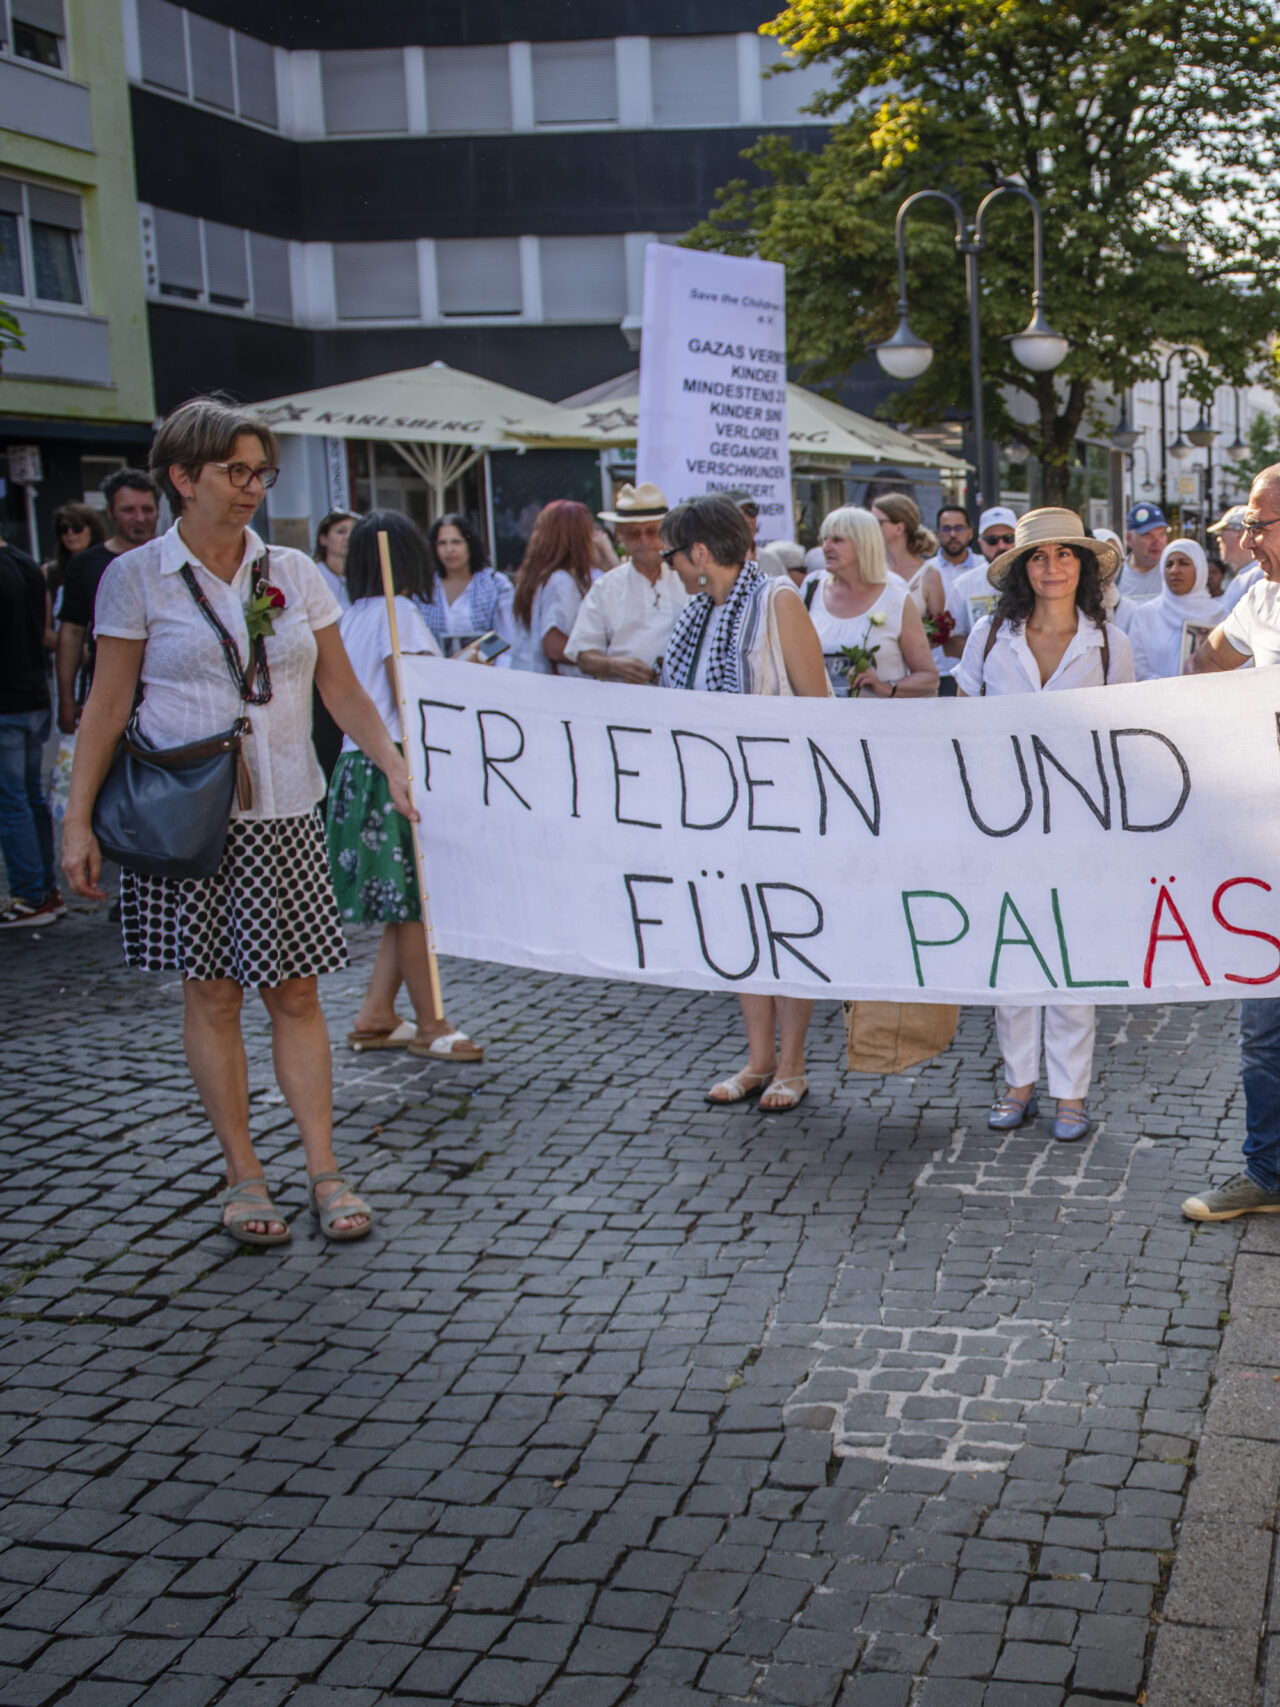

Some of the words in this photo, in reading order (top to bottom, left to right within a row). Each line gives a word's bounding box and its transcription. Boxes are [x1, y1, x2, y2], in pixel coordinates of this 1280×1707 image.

[691, 288, 718, 301] Save
[721, 294, 739, 304] the
[688, 338, 745, 359] GAZAS
[710, 396, 763, 420] KINDER
[315, 410, 484, 434] KARLSBERG
[418, 698, 882, 838] FRIEDEN
[951, 727, 1193, 839] UND
[623, 868, 832, 984] FÜR
